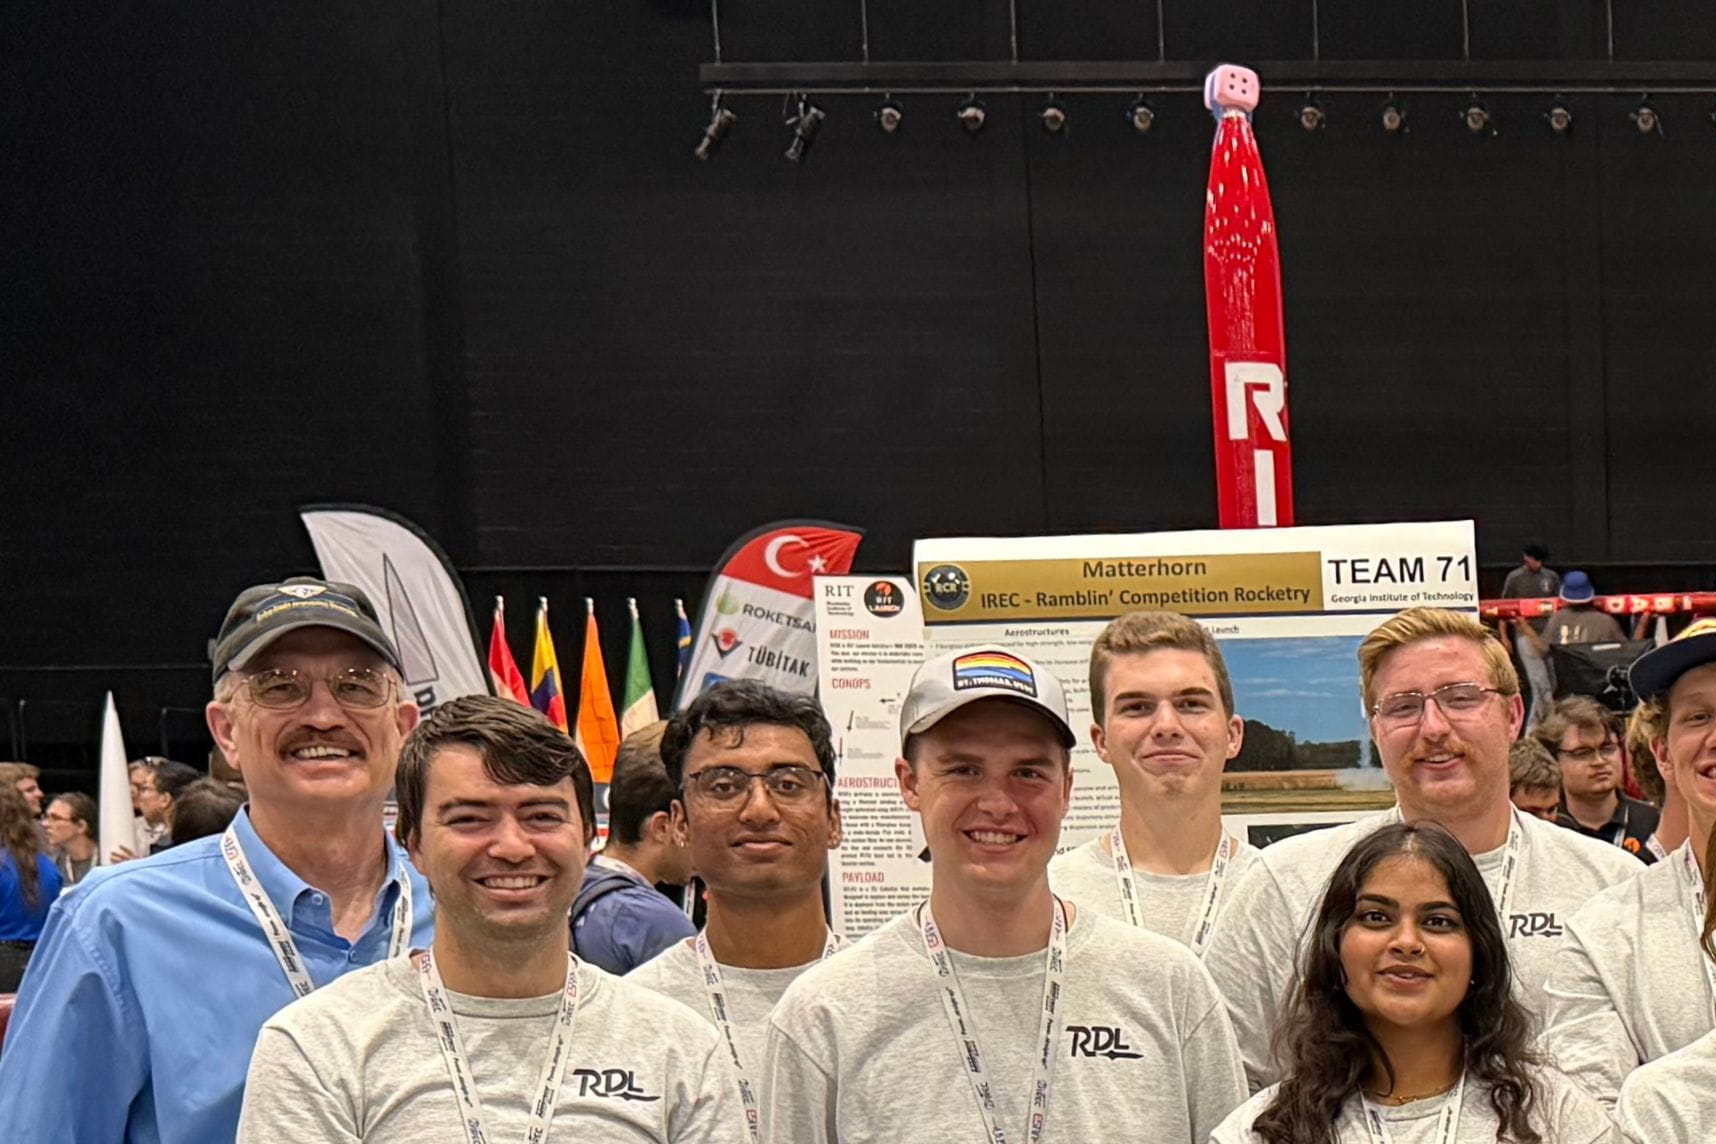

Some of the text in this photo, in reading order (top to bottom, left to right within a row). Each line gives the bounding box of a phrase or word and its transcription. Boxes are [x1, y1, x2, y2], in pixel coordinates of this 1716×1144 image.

[1083, 558, 1206, 578] Matterhorn
[1327, 556, 1470, 584] TEAM 71
[825, 585, 854, 598] RIT
[935, 582, 957, 593] RCR
[981, 592, 1020, 608] IREC
[1119, 587, 1228, 608] Competition
[1234, 585, 1310, 604] Rocketry
[1330, 591, 1473, 604] Georgia Institute of Technology
[829, 629, 870, 640] MISSION
[1004, 628, 1069, 637] Aerostructures
[832, 678, 871, 690] CONOPS
[842, 872, 885, 883] PAYLOAD
[1509, 912, 1562, 938] RDL
[1066, 1027, 1136, 1058] RDL
[573, 1069, 650, 1099] RDL
